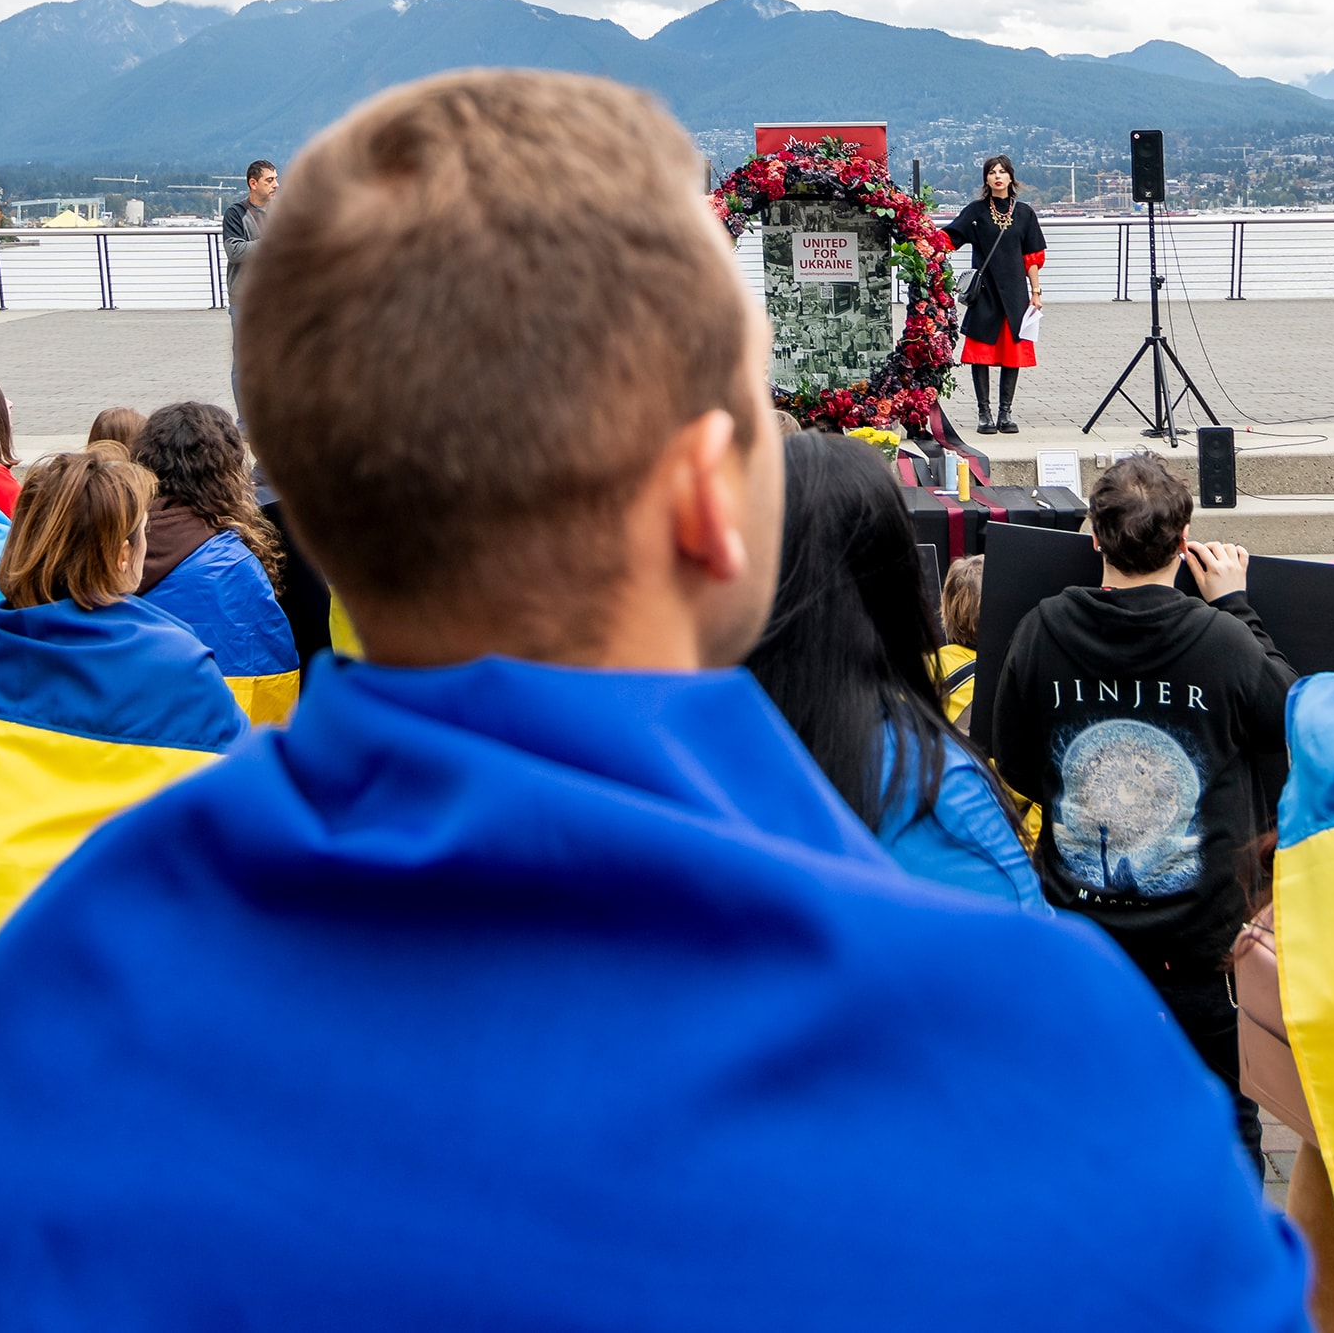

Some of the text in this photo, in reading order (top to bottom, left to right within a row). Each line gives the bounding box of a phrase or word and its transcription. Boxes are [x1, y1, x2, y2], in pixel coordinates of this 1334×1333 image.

[802, 238, 848, 248] UNITED
[813, 249, 838, 259] FOR
[799, 259, 853, 269] UKRAINE
[1053, 679, 1209, 711] JINJER
